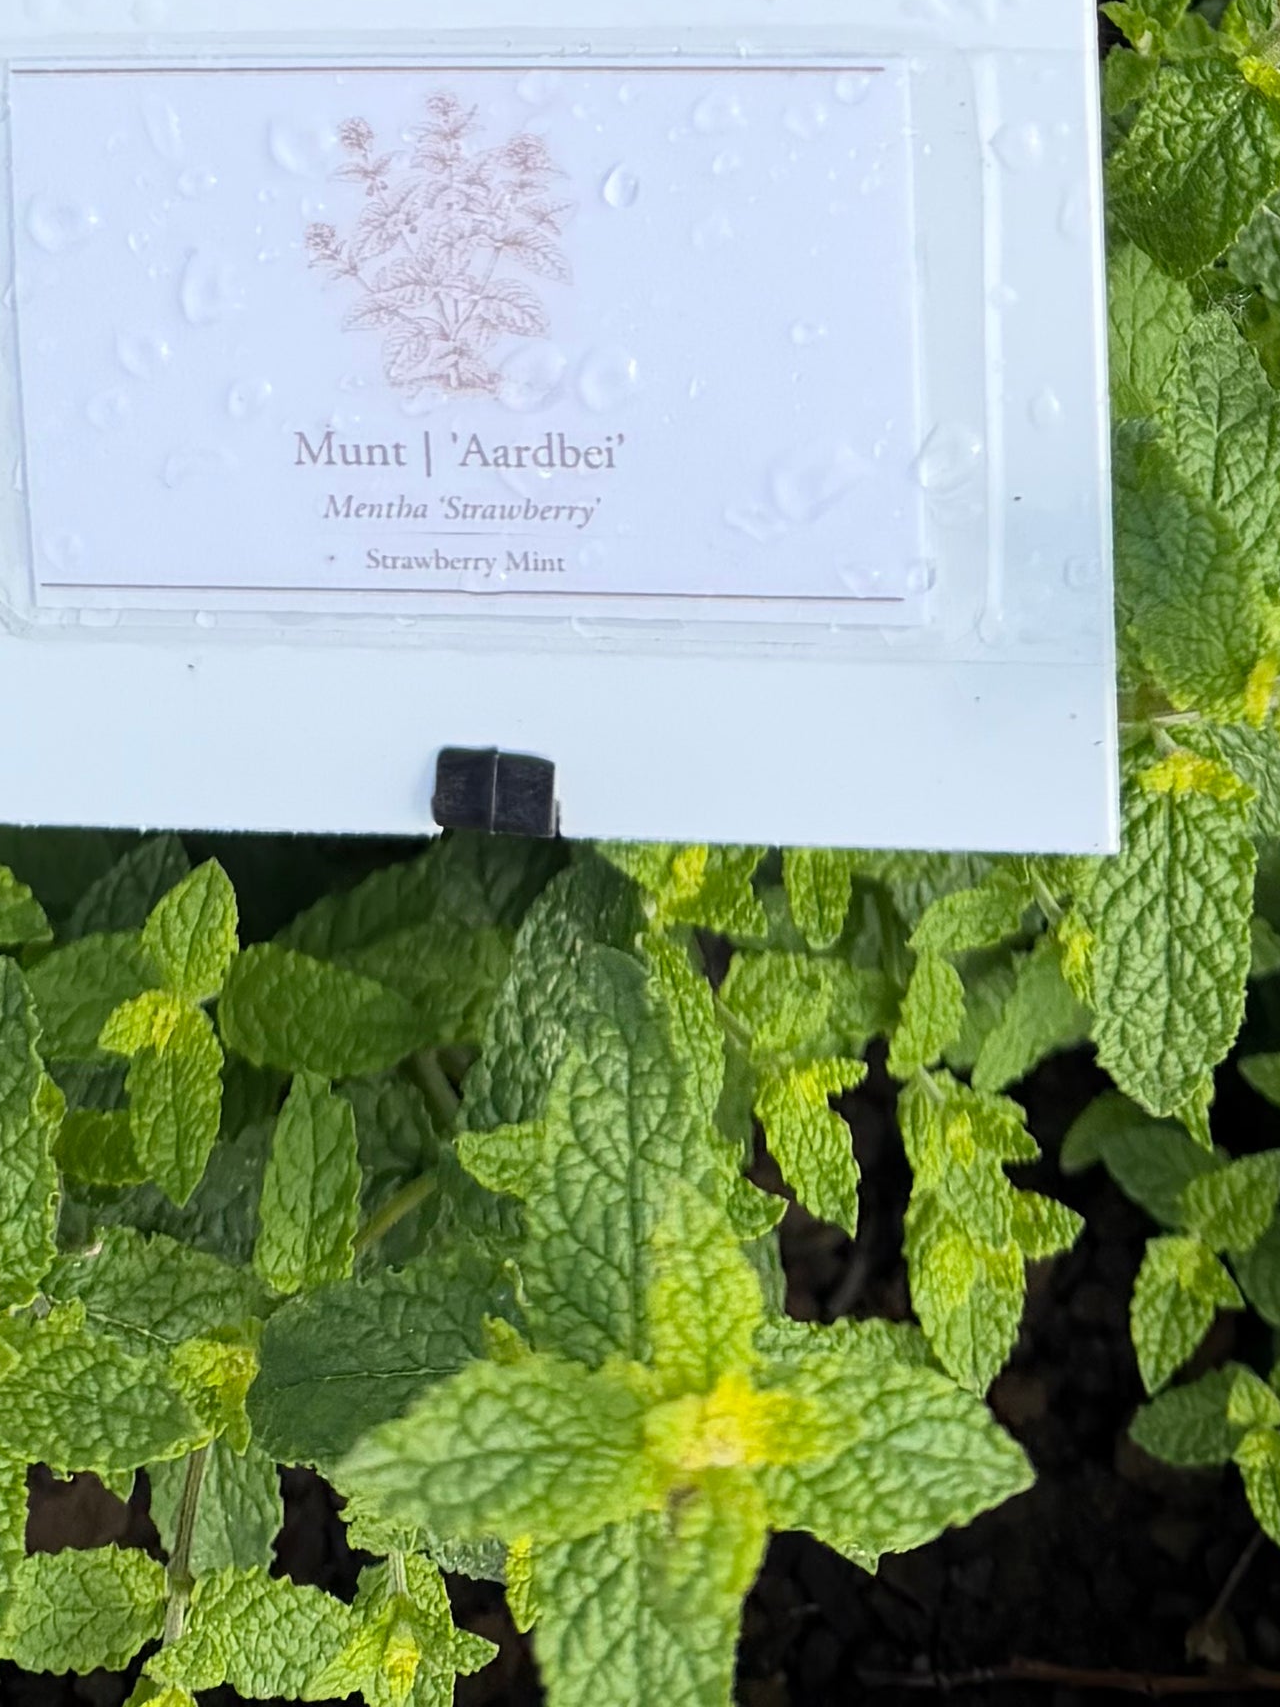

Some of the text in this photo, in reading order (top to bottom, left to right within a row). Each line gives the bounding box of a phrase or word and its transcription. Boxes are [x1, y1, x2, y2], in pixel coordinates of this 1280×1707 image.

[294, 430, 407, 467] Munt
[322, 494, 429, 520] Mentha
[365, 548, 566, 578] Strawberry Mint
